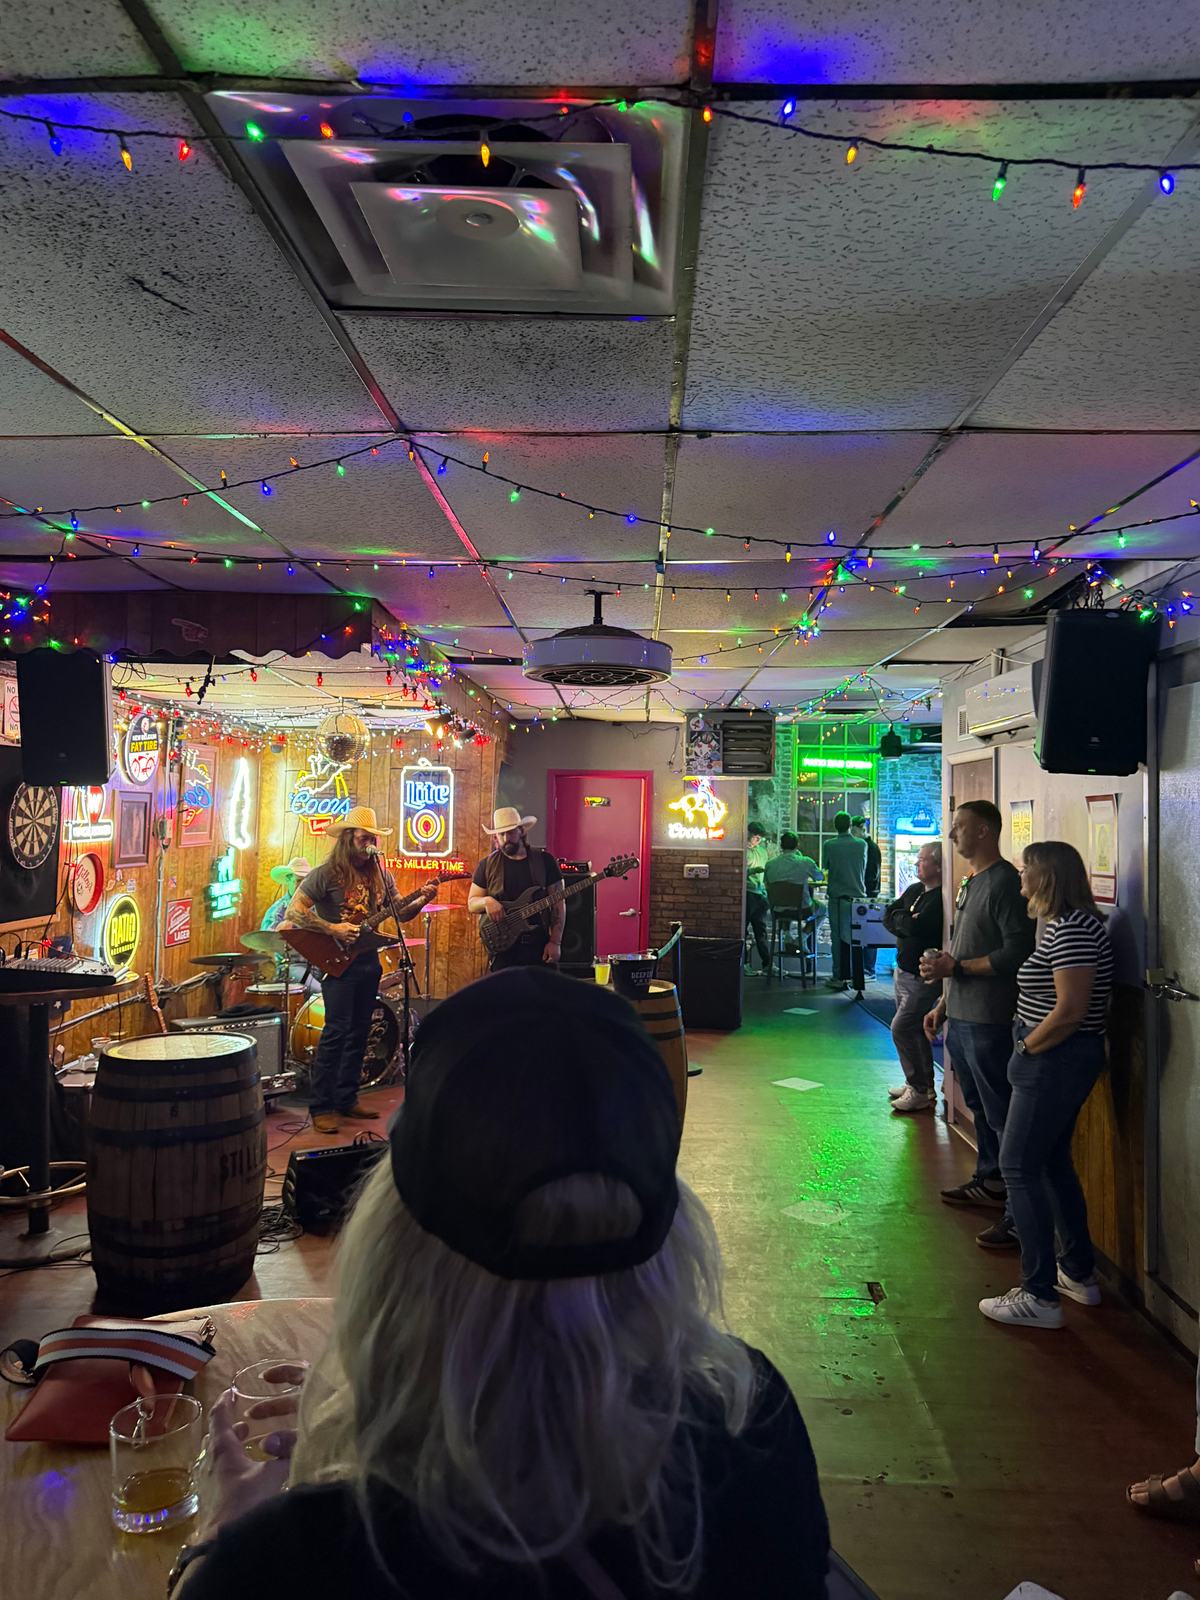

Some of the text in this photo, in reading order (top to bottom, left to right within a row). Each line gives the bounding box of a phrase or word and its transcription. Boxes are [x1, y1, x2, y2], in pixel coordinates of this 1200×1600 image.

[130, 740, 158, 753] FAT TIRE
[288, 791, 351, 814] Coors
[404, 780, 450, 810] Lite
[385, 858, 465, 872] IT'S MILLER TIME
[110, 912, 136, 948] RATIO
[174, 929, 190, 941] LAGER
